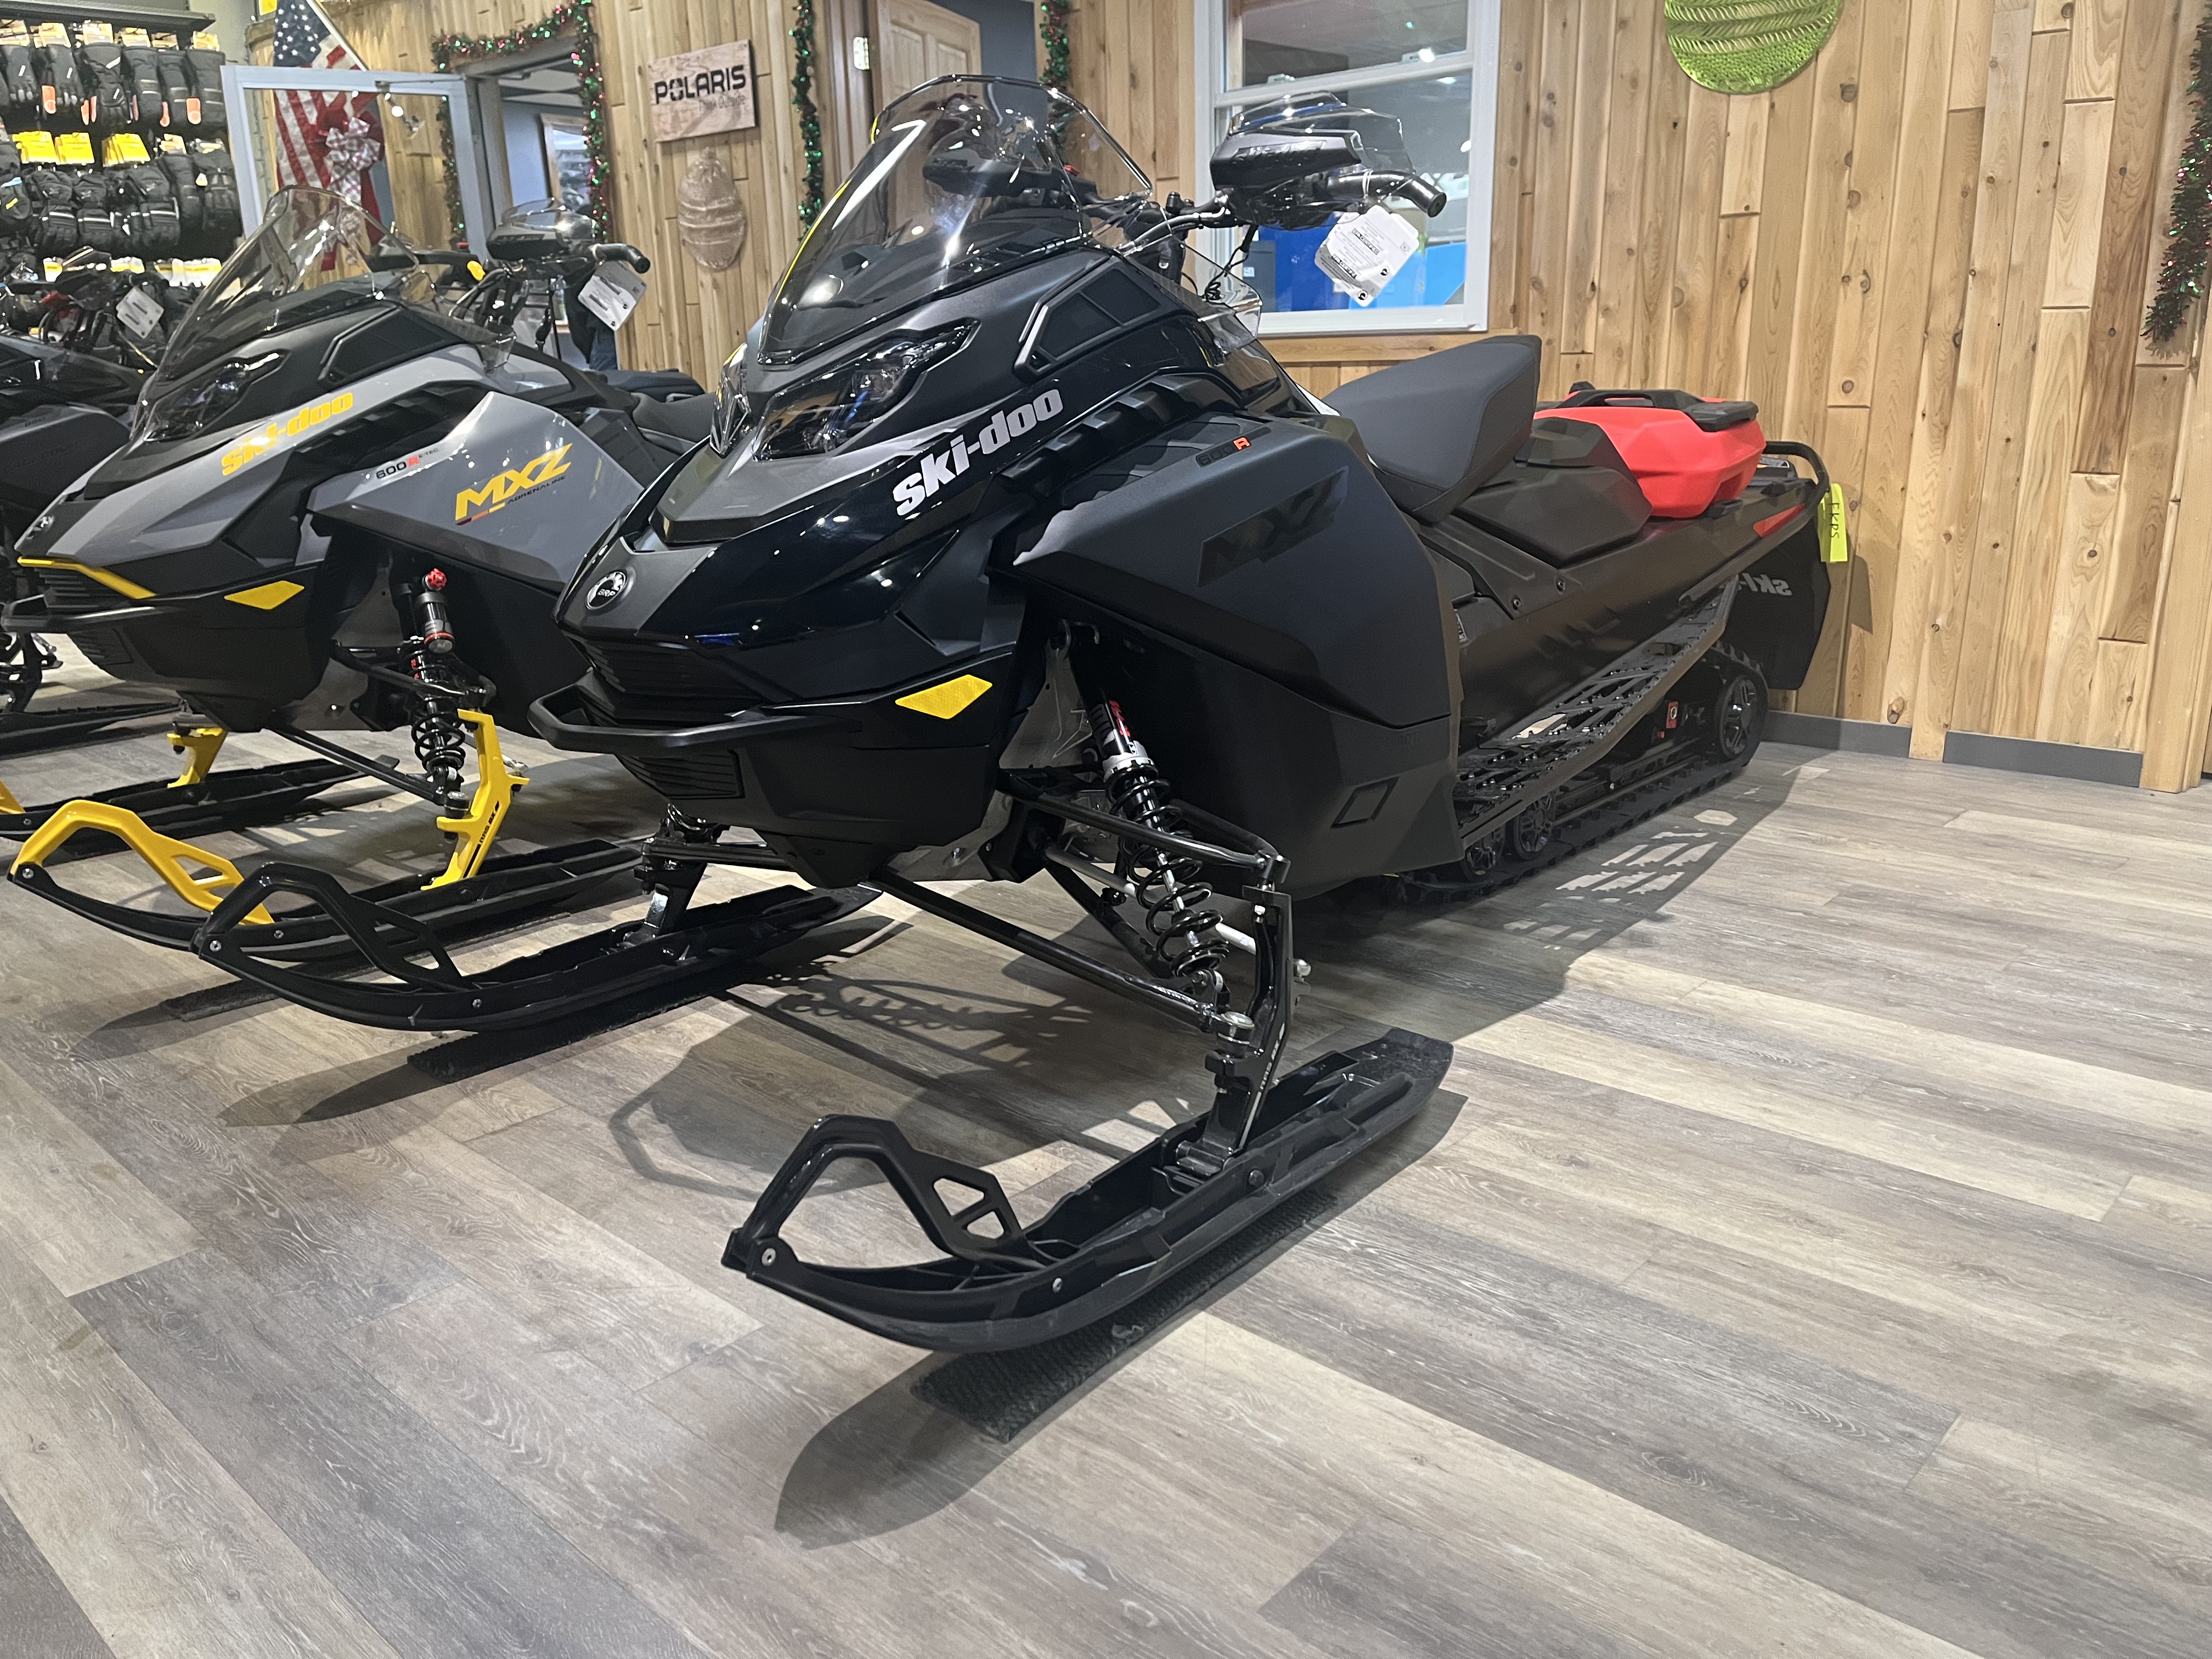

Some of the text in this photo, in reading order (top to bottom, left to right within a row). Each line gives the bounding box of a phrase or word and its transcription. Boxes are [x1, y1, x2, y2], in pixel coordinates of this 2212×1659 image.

[654, 65, 747, 104] POLARIS
[455, 443, 573, 521] MXZ
[506, 475, 566, 505] ADRENALINE
[598, 588, 616, 597] BRP
